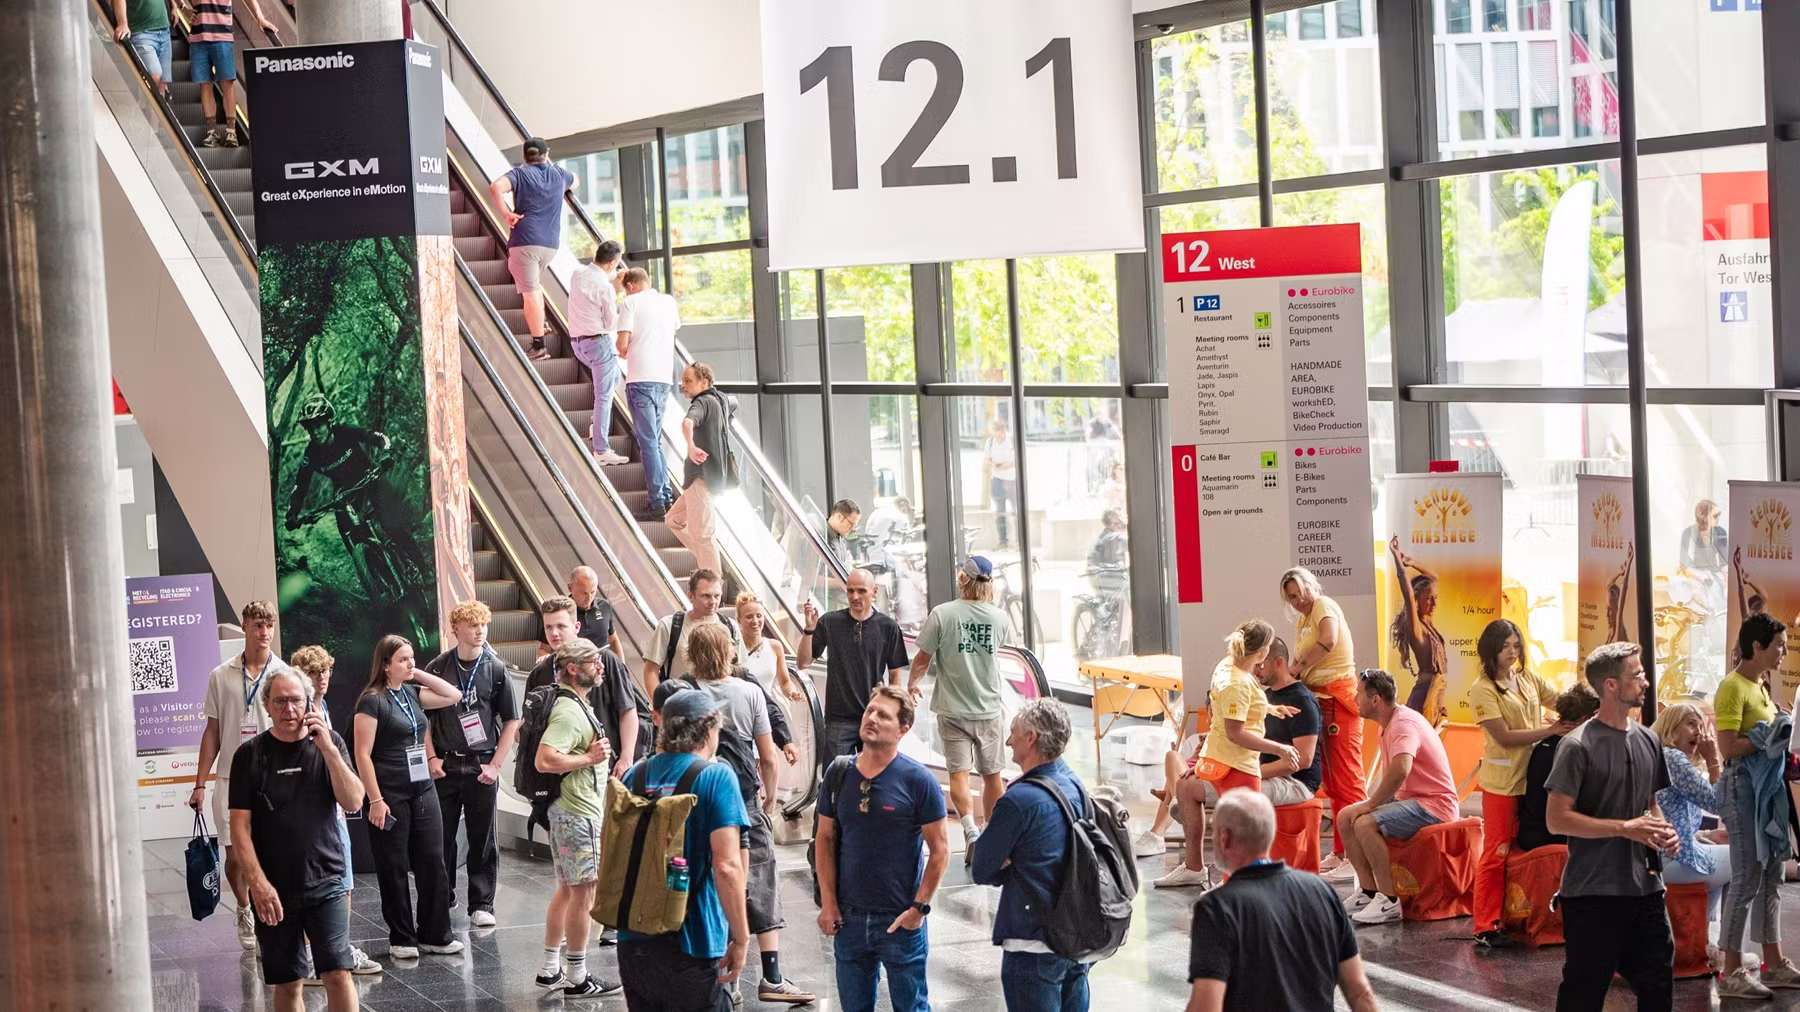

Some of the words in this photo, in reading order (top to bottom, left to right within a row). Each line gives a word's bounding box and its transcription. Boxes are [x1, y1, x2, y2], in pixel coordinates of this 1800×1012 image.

[255, 51, 354, 73] Panasonic
[408, 47, 432, 69] Panasonic
[800, 37, 1077, 190] 12.1
[285, 158, 379, 180] GXM
[420, 156, 442, 174] GXM
[261, 191, 290, 202] Great
[292, 188, 350, 201] eXperience
[352, 186, 361, 196] in
[363, 184, 406, 195] eMotion
[1171, 240, 1210, 273] 12
[1218, 257, 1255, 270] West
[1717, 252, 1770, 266] Ausfahr
[1717, 272, 1739, 284] Tor
[1743, 271, 1772, 283] Wes
[1312, 286, 1355, 296] Eurobike
[1177, 297, 1184, 313] 1
[1197, 298, 1204, 308] P
[1207, 299, 1218, 308] 12
[1288, 301, 1336, 310] Accessoires
[1288, 313, 1339, 323] Components
[1289, 326, 1332, 335] Equipment
[1290, 339, 1310, 347] Parts
[1291, 360, 1342, 370] HANDMADE
[1291, 374, 1316, 383] AREA,
[1198, 391, 1217, 399] Onyx,
[1219, 390, 1234, 398] Opal
[1292, 385, 1334, 395] EUROBIKE
[1199, 400, 1215, 408] Pyrit,
[1292, 398, 1335, 407] workshED,
[1293, 410, 1335, 419] BikeCheck
[1199, 419, 1221, 427] Saphir
[1318, 421, 1362, 430] Production
[1200, 427, 1229, 435] Smaragd
[1319, 446, 1362, 455] Eurobike
[1181, 454, 1193, 472] 0
[1295, 461, 1316, 469] Bikes
[1295, 473, 1325, 481] E-Bikes
[1296, 497, 1348, 506] Components
[1202, 509, 1220, 517] Open
[1234, 507, 1263, 515] grounds
[1297, 520, 1340, 529] EUROBIKE
[1297, 533, 1331, 541] CAREER
[1298, 545, 1334, 554] CENTER,
[1299, 556, 1342, 566] EUROBIKE
[1462, 606, 1475, 615] 1/4
[1477, 606, 1495, 614] hour
[127, 614, 202, 629] EGISTERED?
[160, 702, 193, 711] Visitor
[140, 715, 170, 725] please
[173, 714, 195, 722] scan
[136, 728, 151, 736] ow
[154, 727, 164, 735] to
[167, 724, 202, 734] register
